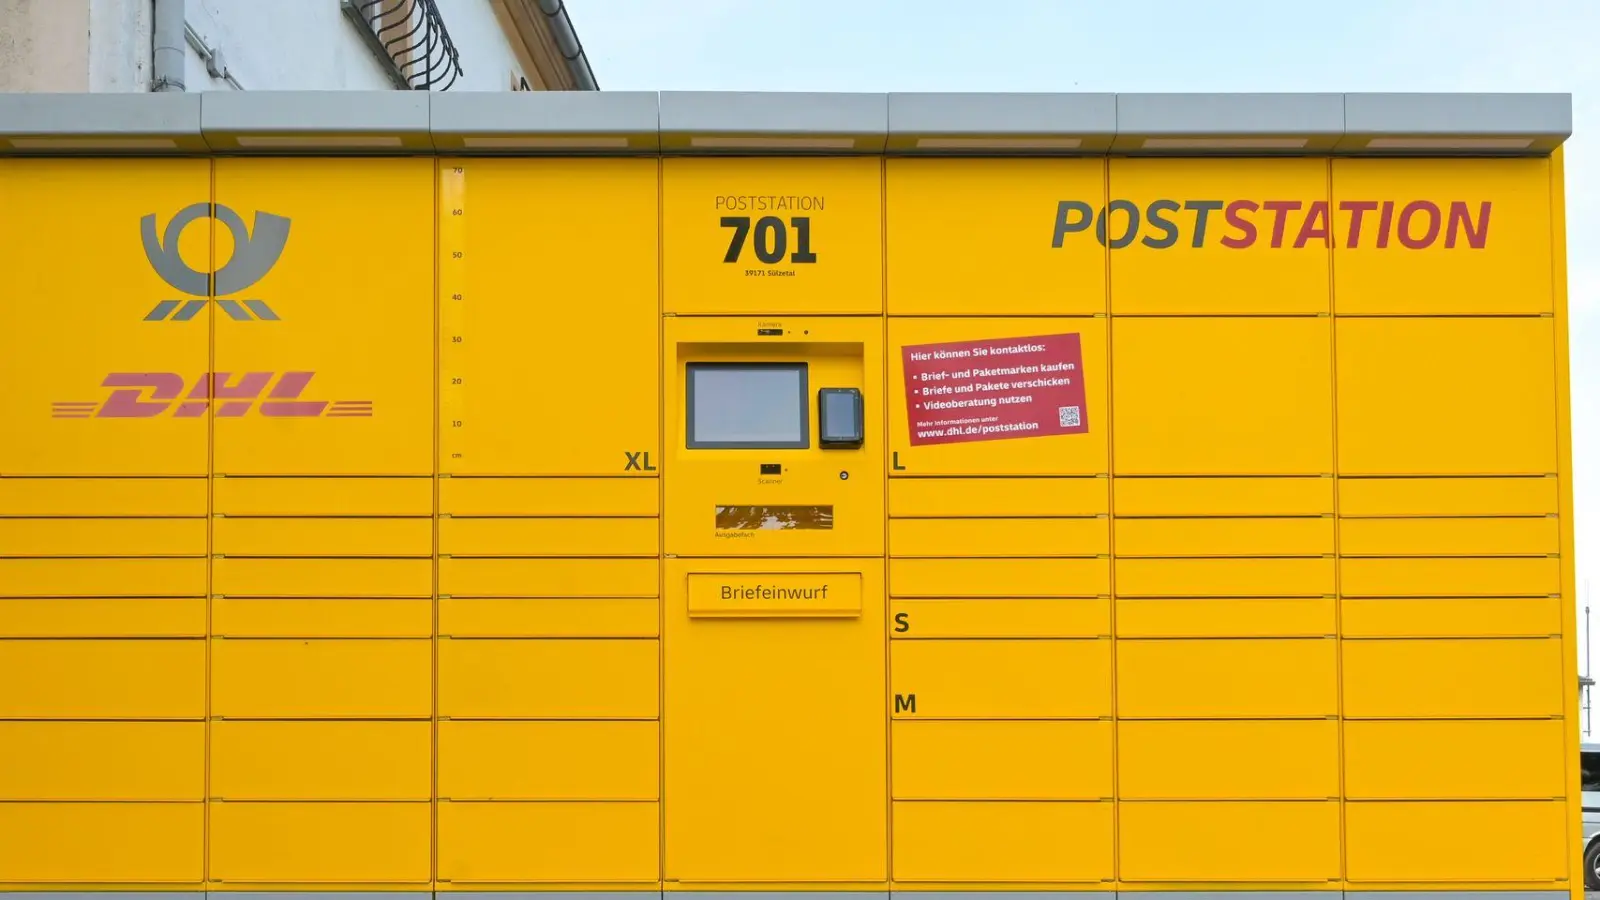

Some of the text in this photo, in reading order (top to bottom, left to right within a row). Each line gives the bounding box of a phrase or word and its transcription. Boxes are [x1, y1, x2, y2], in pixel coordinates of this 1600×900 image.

[716, 196, 825, 211] POSTSTATION
[452, 208, 463, 216] 60
[1051, 199, 1492, 249] POSTSTATION
[720, 216, 817, 264] 701
[452, 251, 463, 259] 50
[745, 268, 796, 277] 39171 Sülzetal
[451, 293, 462, 301] 40
[452, 335, 462, 343] 30
[910, 343, 1046, 361] Hier können Sie kontaktlos:
[921, 361, 1075, 382] Brief- und Paketmarken kaufen
[452, 377, 462, 385] 20
[922, 377, 1070, 396] Briefe und Pakete verschicken
[94, 371, 330, 418] DHL
[923, 395, 1033, 410] Videoberatung nutzen
[452, 420, 462, 428] 10
[934, 417, 980, 426] Informationen
[917, 421, 1039, 438] www.dhl.de/poststation
[624, 451, 657, 471] XL
[892, 451, 906, 471] L
[757, 477, 783, 485] Scanner
[714, 531, 756, 540] Ausgabefach
[720, 584, 829, 600] Briefeinwurf
[893, 612, 910, 633] S
[893, 694, 917, 713] M
